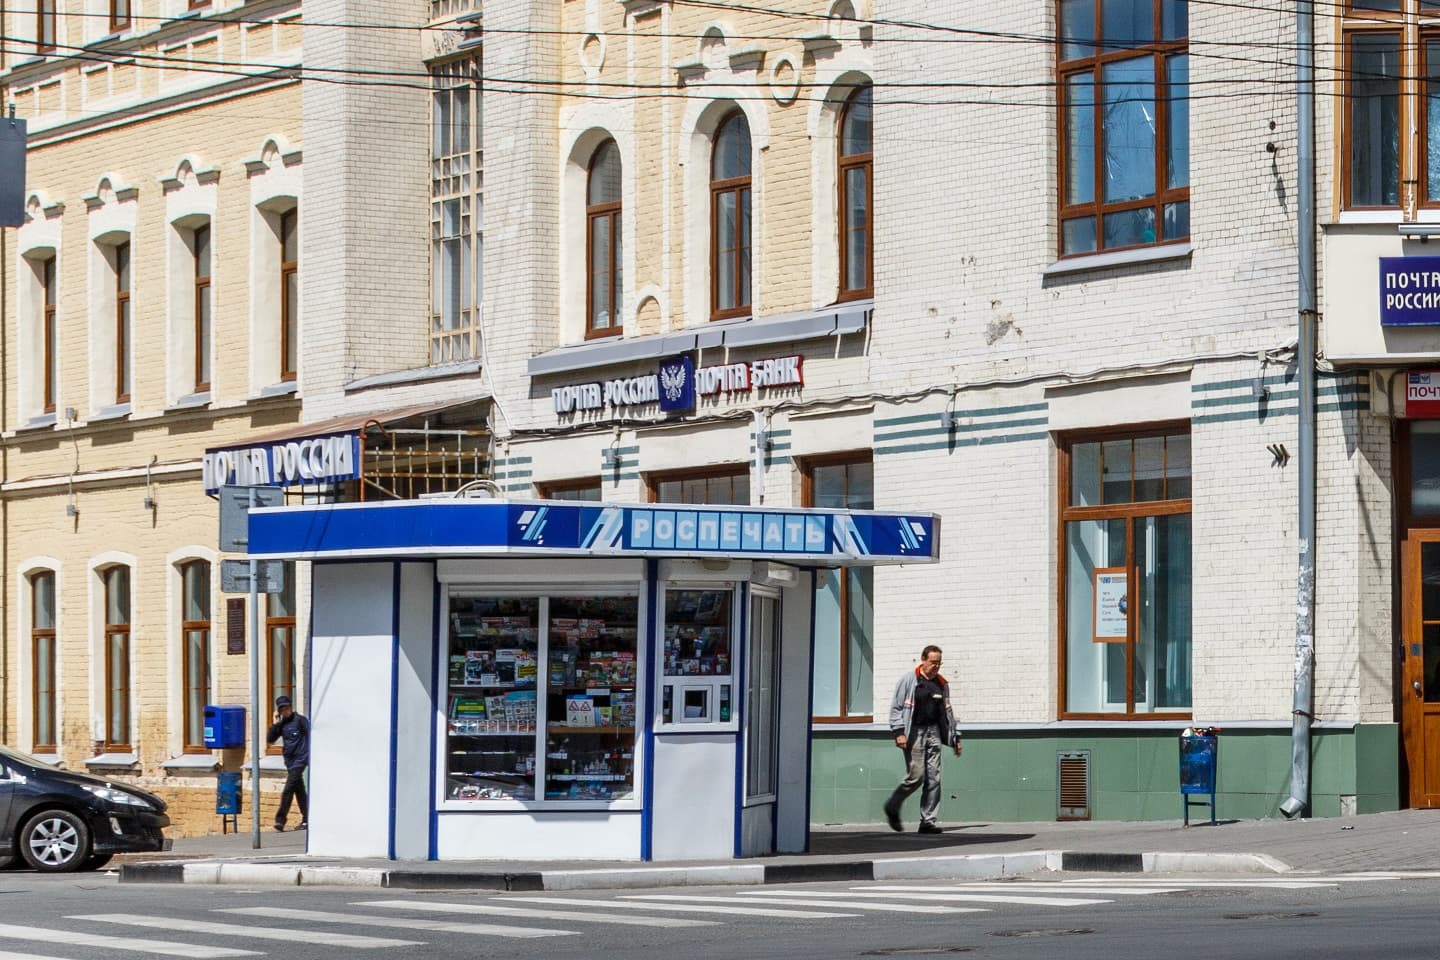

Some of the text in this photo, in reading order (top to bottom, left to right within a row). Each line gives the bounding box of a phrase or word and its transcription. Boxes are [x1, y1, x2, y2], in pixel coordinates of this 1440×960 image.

[551, 354, 803, 414] ПОЧТА РОССИИ ПОЧТА БАНК
[203, 434, 354, 491] ПОЧТА РОССИИ
[633, 517, 826, 545] РОСПЕЧАТЬ
